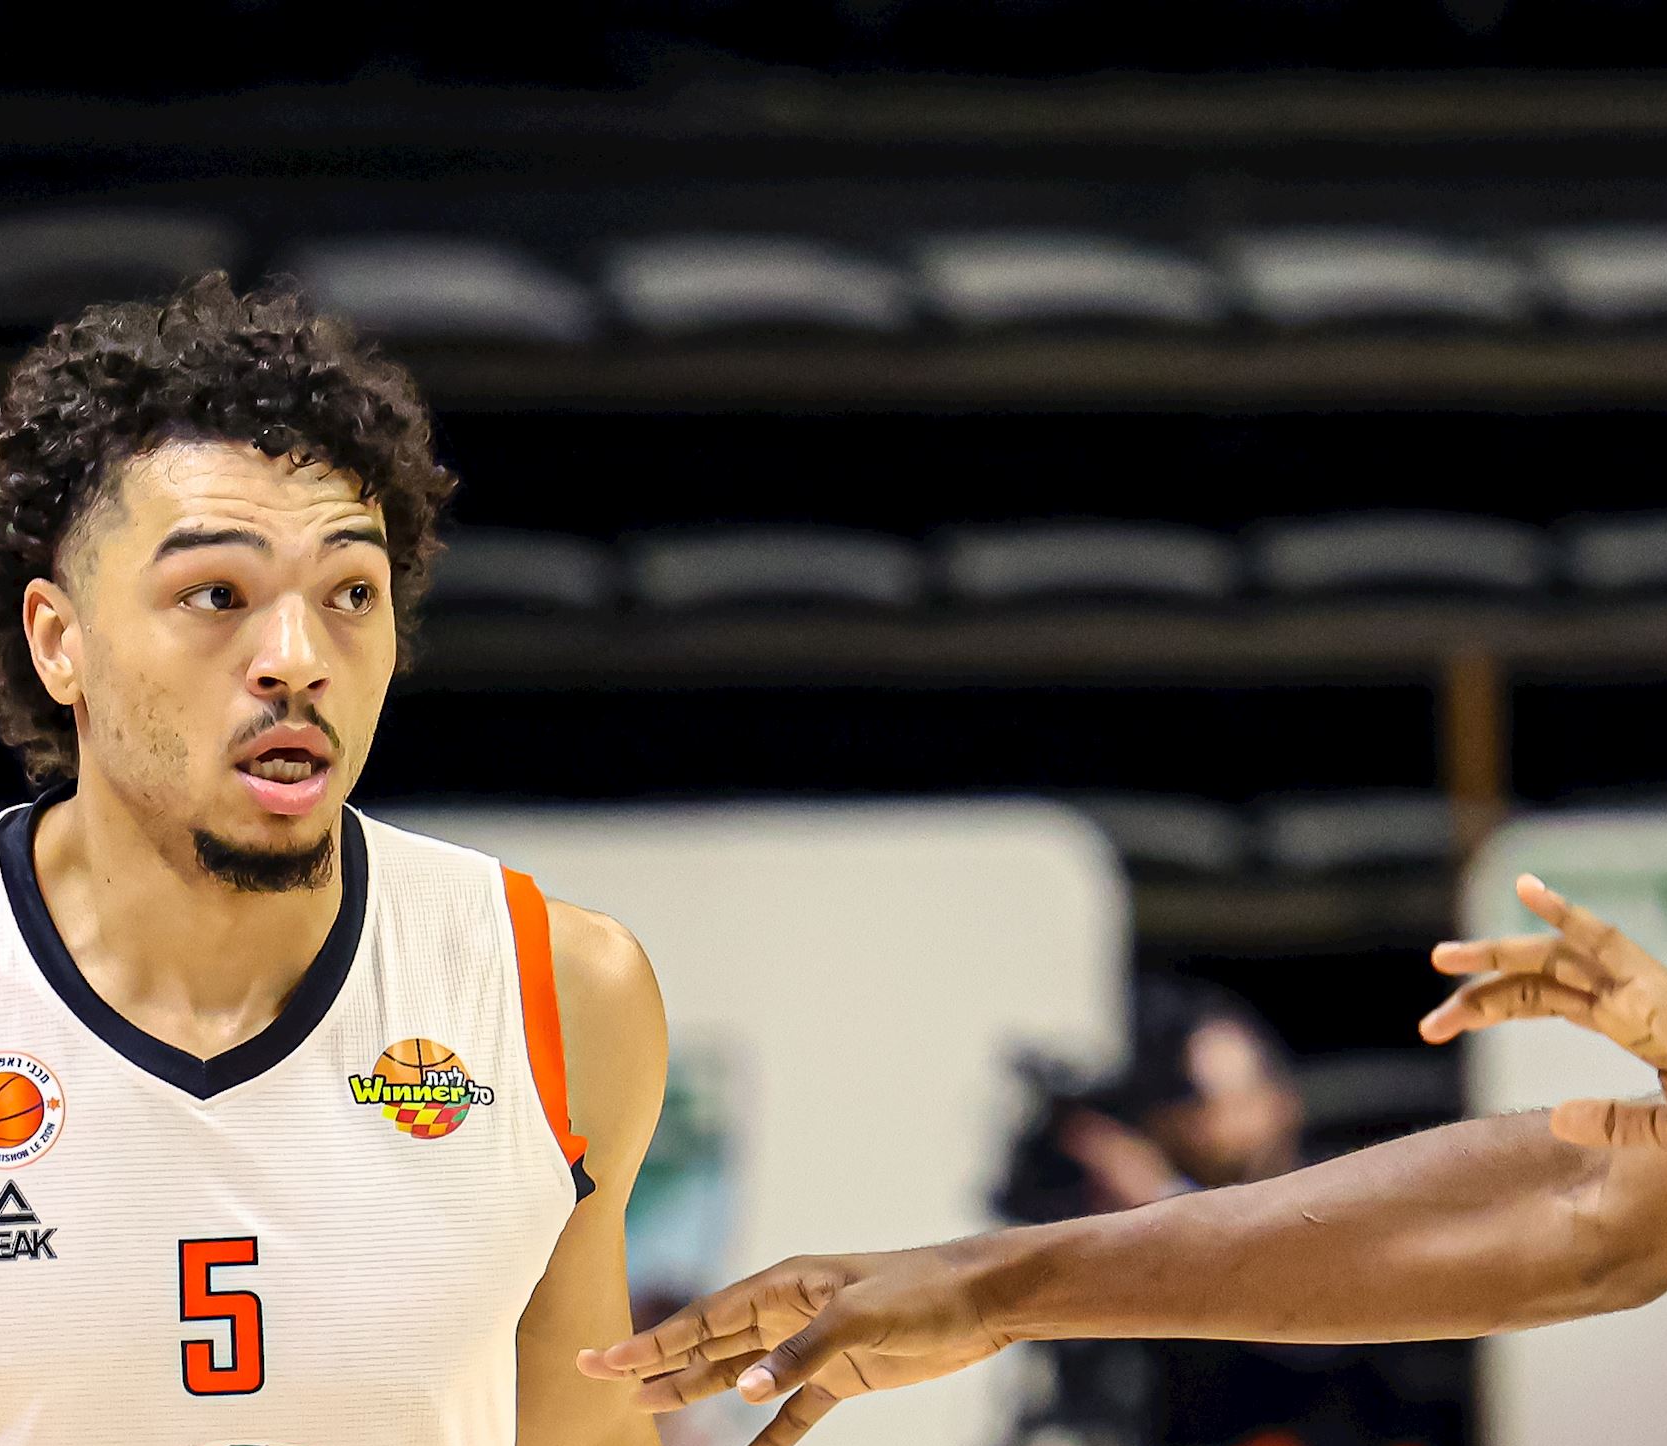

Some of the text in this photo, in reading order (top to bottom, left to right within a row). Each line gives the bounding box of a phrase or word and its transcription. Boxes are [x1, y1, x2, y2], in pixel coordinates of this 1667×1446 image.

[26, 1060, 50, 1084] מכבי
[425, 1066, 465, 1086] ליגת
[349, 1074, 494, 1105] Winner סל
[30, 1141, 42, 1153] LE
[39, 1122, 56, 1144] ZION
[178, 1236, 265, 1397] 5
